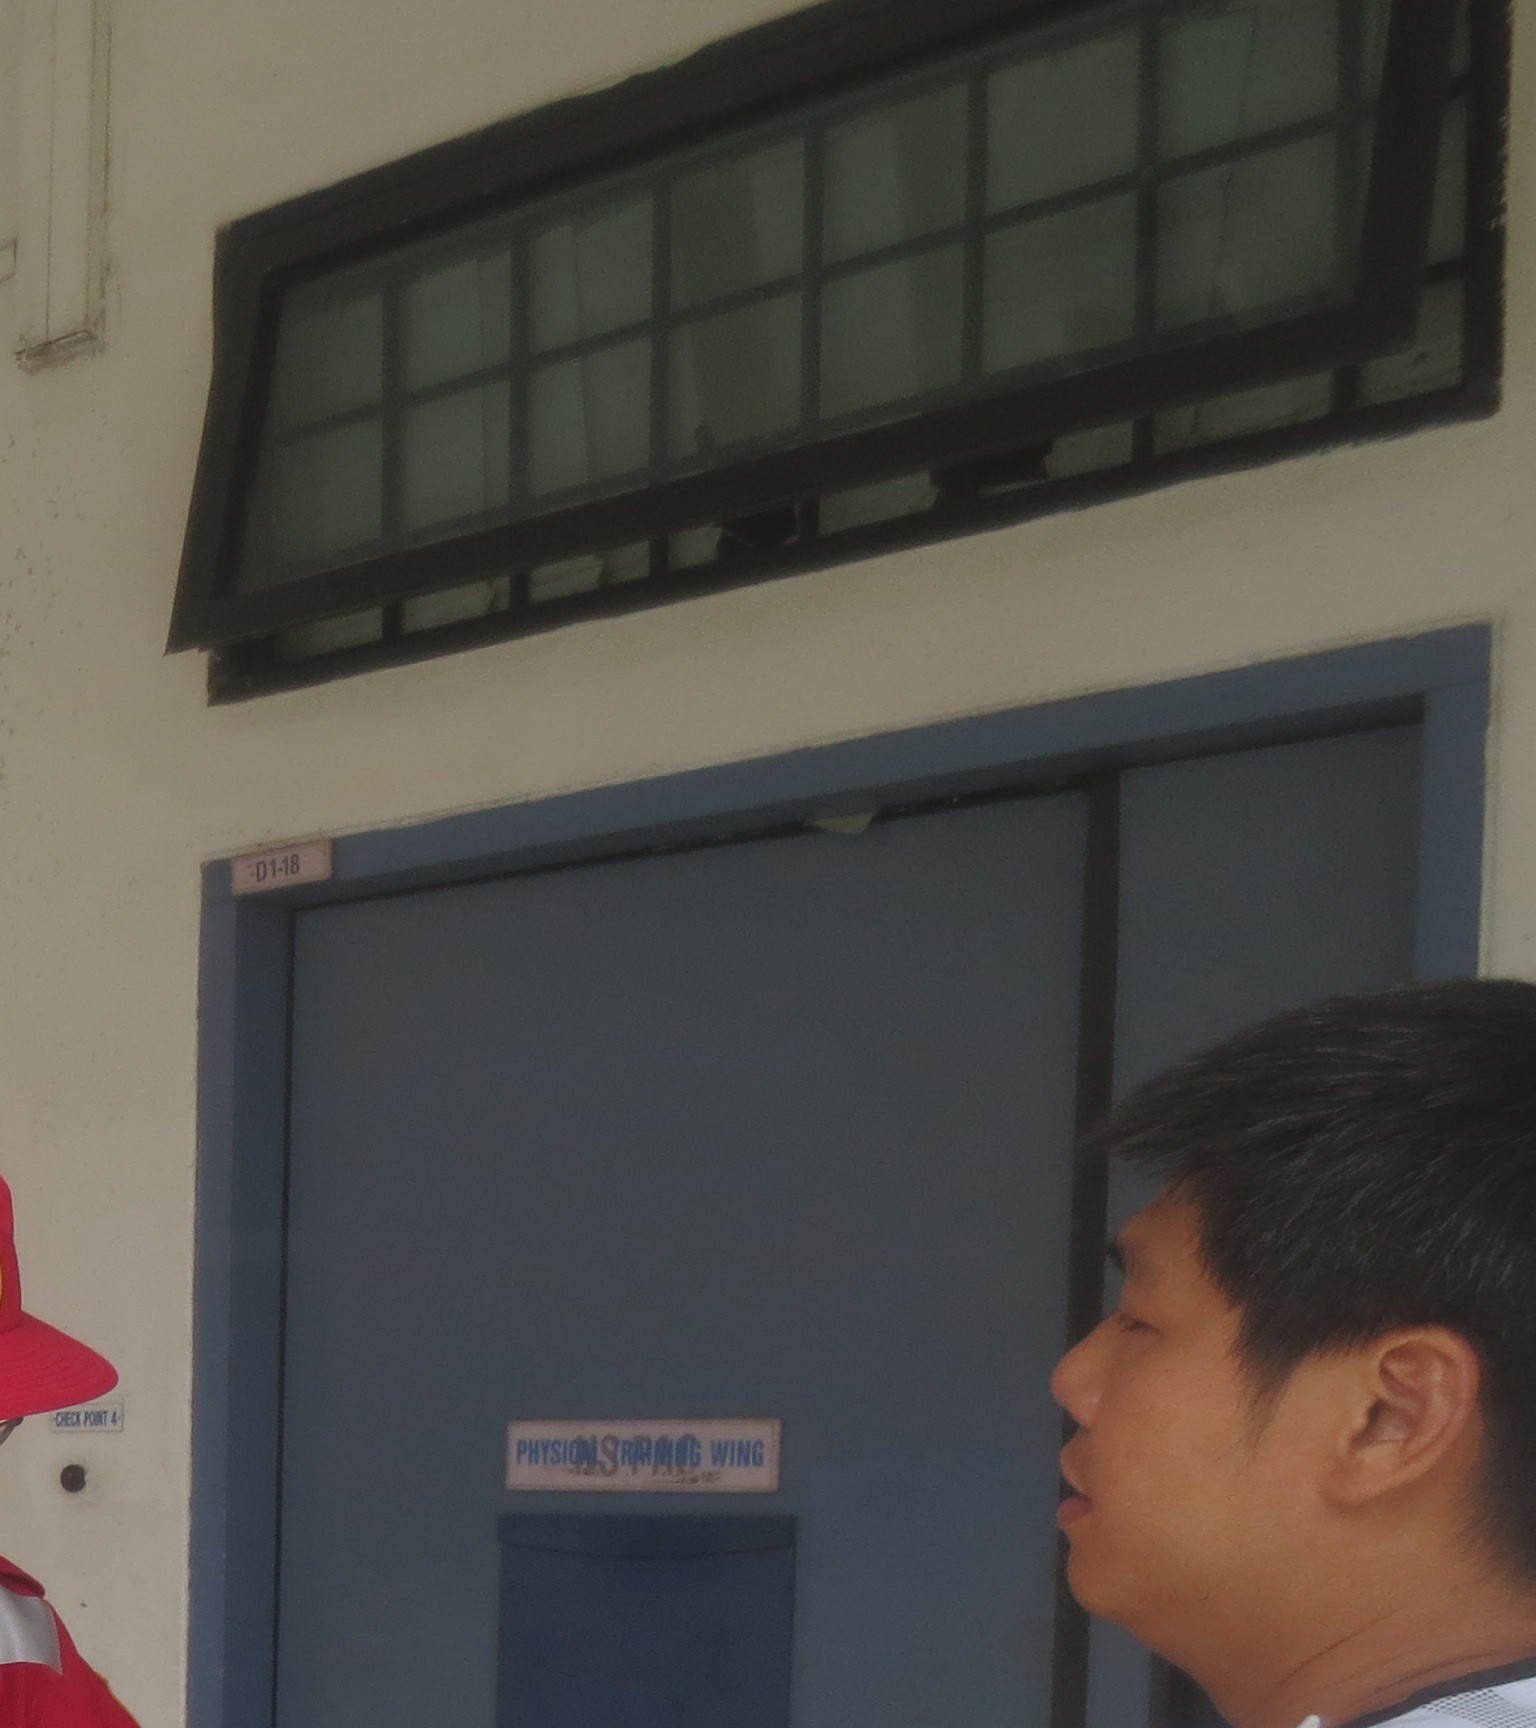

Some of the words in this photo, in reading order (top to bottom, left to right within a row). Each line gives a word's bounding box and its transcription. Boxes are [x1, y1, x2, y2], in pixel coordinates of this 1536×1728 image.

[256, 854, 300, 882] D1-18
[55, 1412, 81, 1428] CHECK
[84, 1410, 107, 1428] POINT
[711, 1439, 765, 1468] WING
